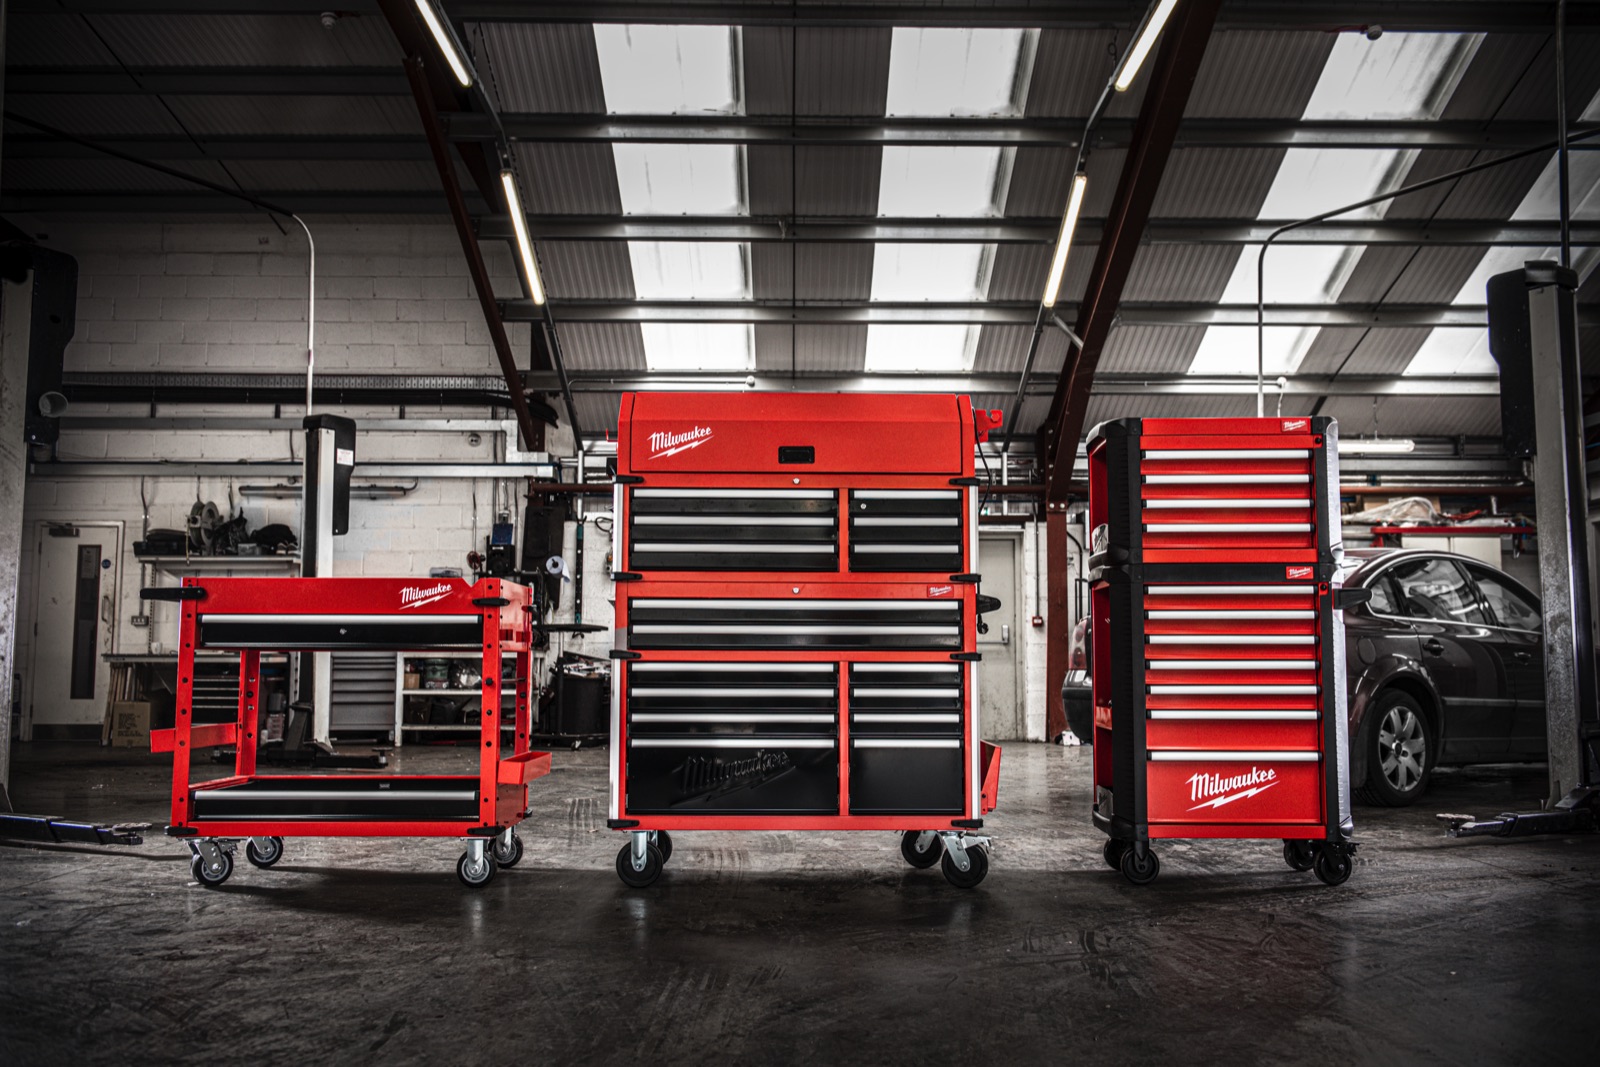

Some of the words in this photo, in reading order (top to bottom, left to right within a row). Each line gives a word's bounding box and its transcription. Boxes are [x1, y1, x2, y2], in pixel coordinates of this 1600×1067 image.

[646, 425, 713, 453] Milwaukee
[398, 582, 453, 604] Milwaukee
[1185, 766, 1277, 801] Milwaukee
